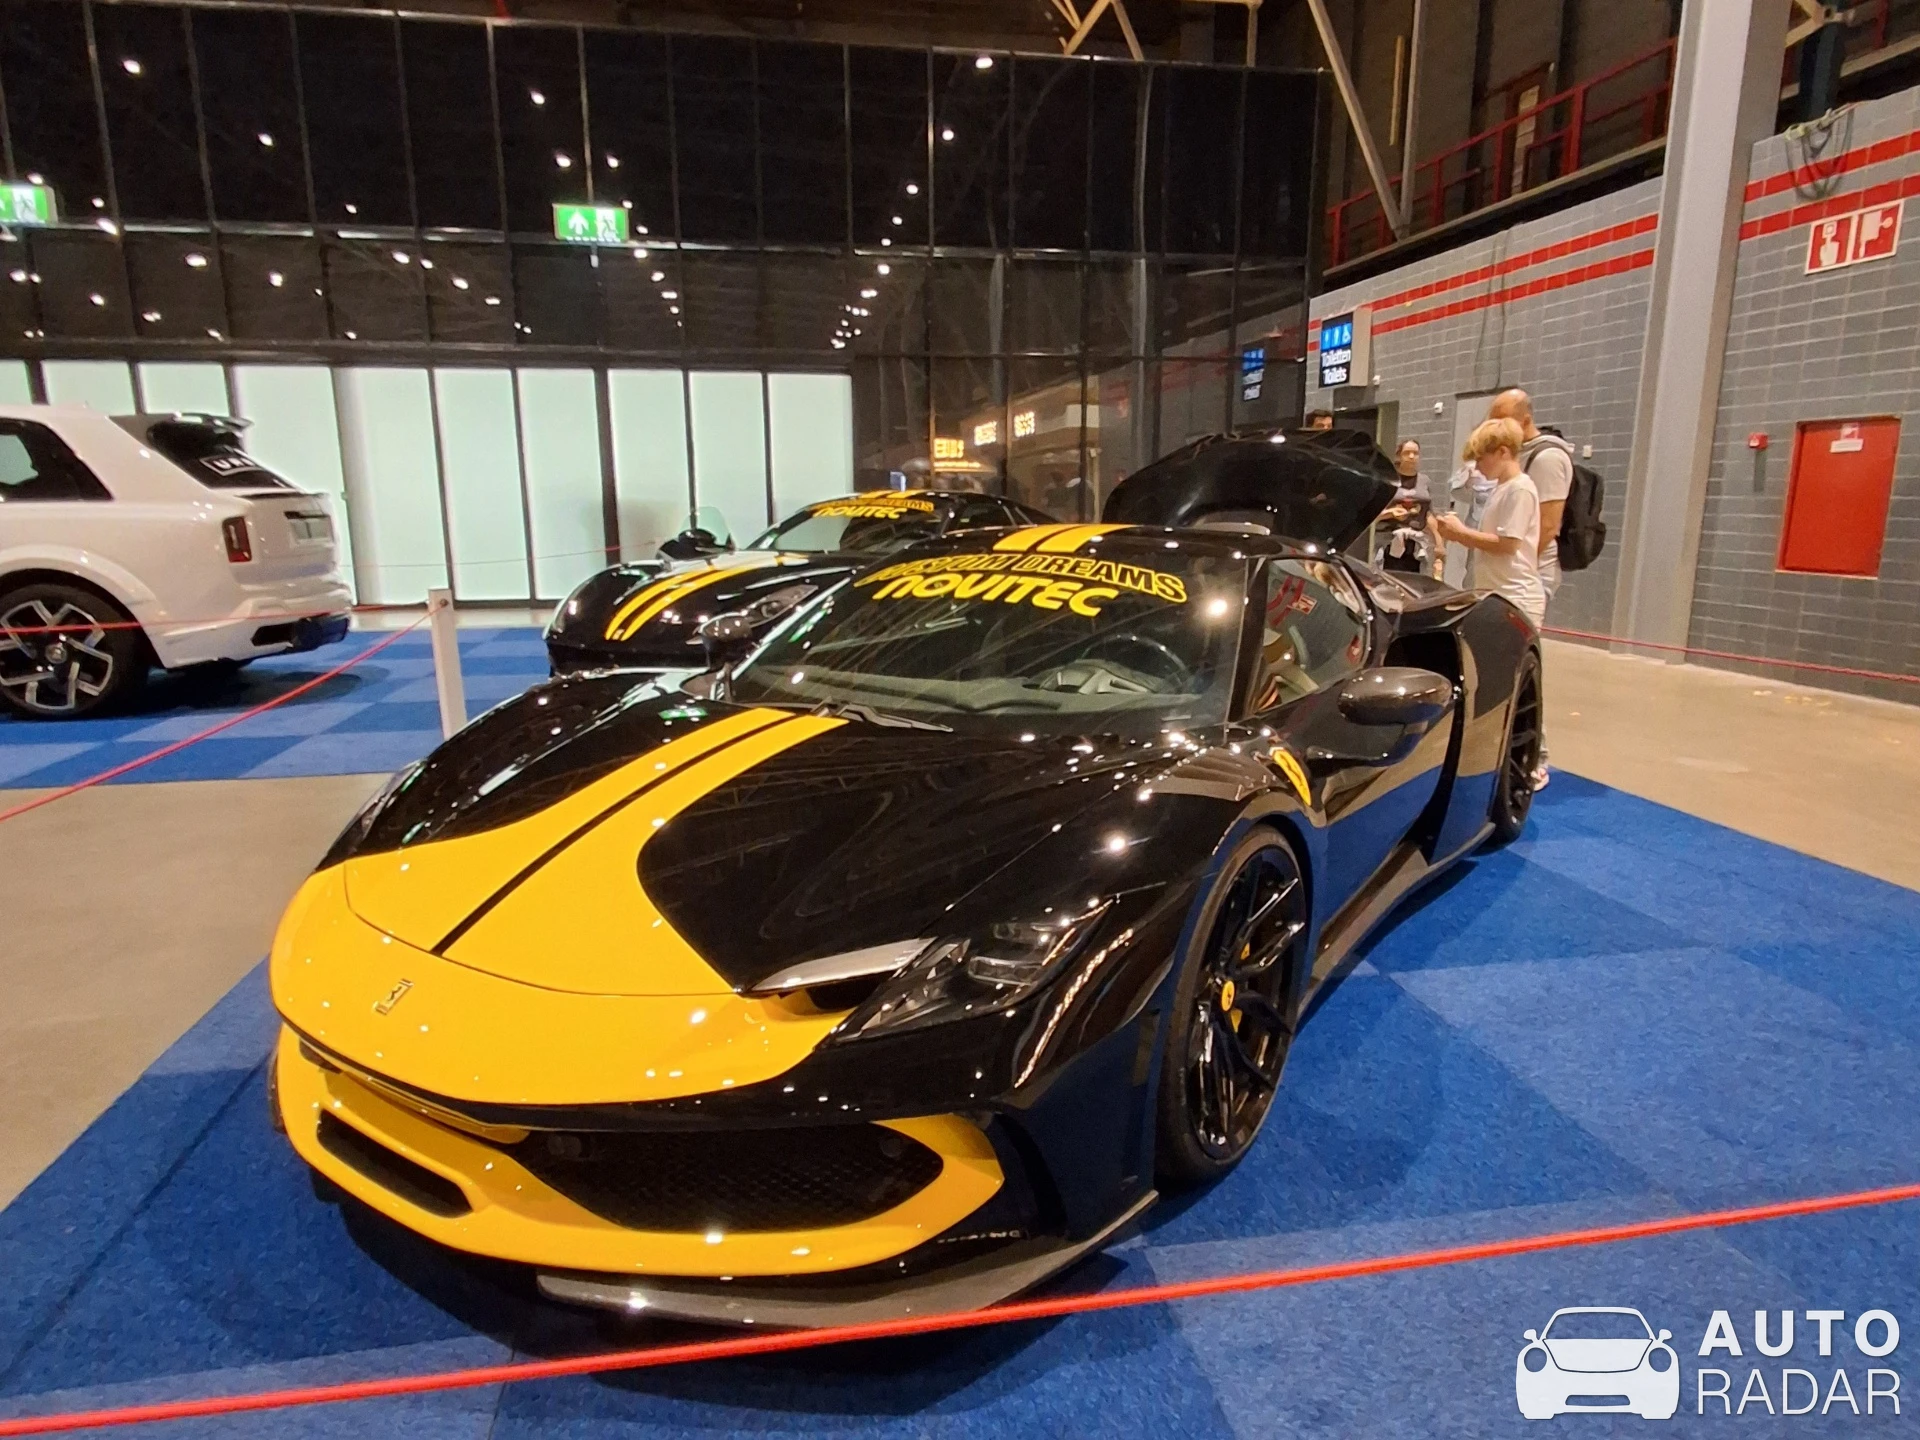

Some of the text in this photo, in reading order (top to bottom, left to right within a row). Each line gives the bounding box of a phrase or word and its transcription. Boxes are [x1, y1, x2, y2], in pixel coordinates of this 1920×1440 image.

[1321, 349, 1351, 367] Toiletten
[1323, 366, 1347, 385] Toilets
[1011, 554, 1188, 603] DREAMS
